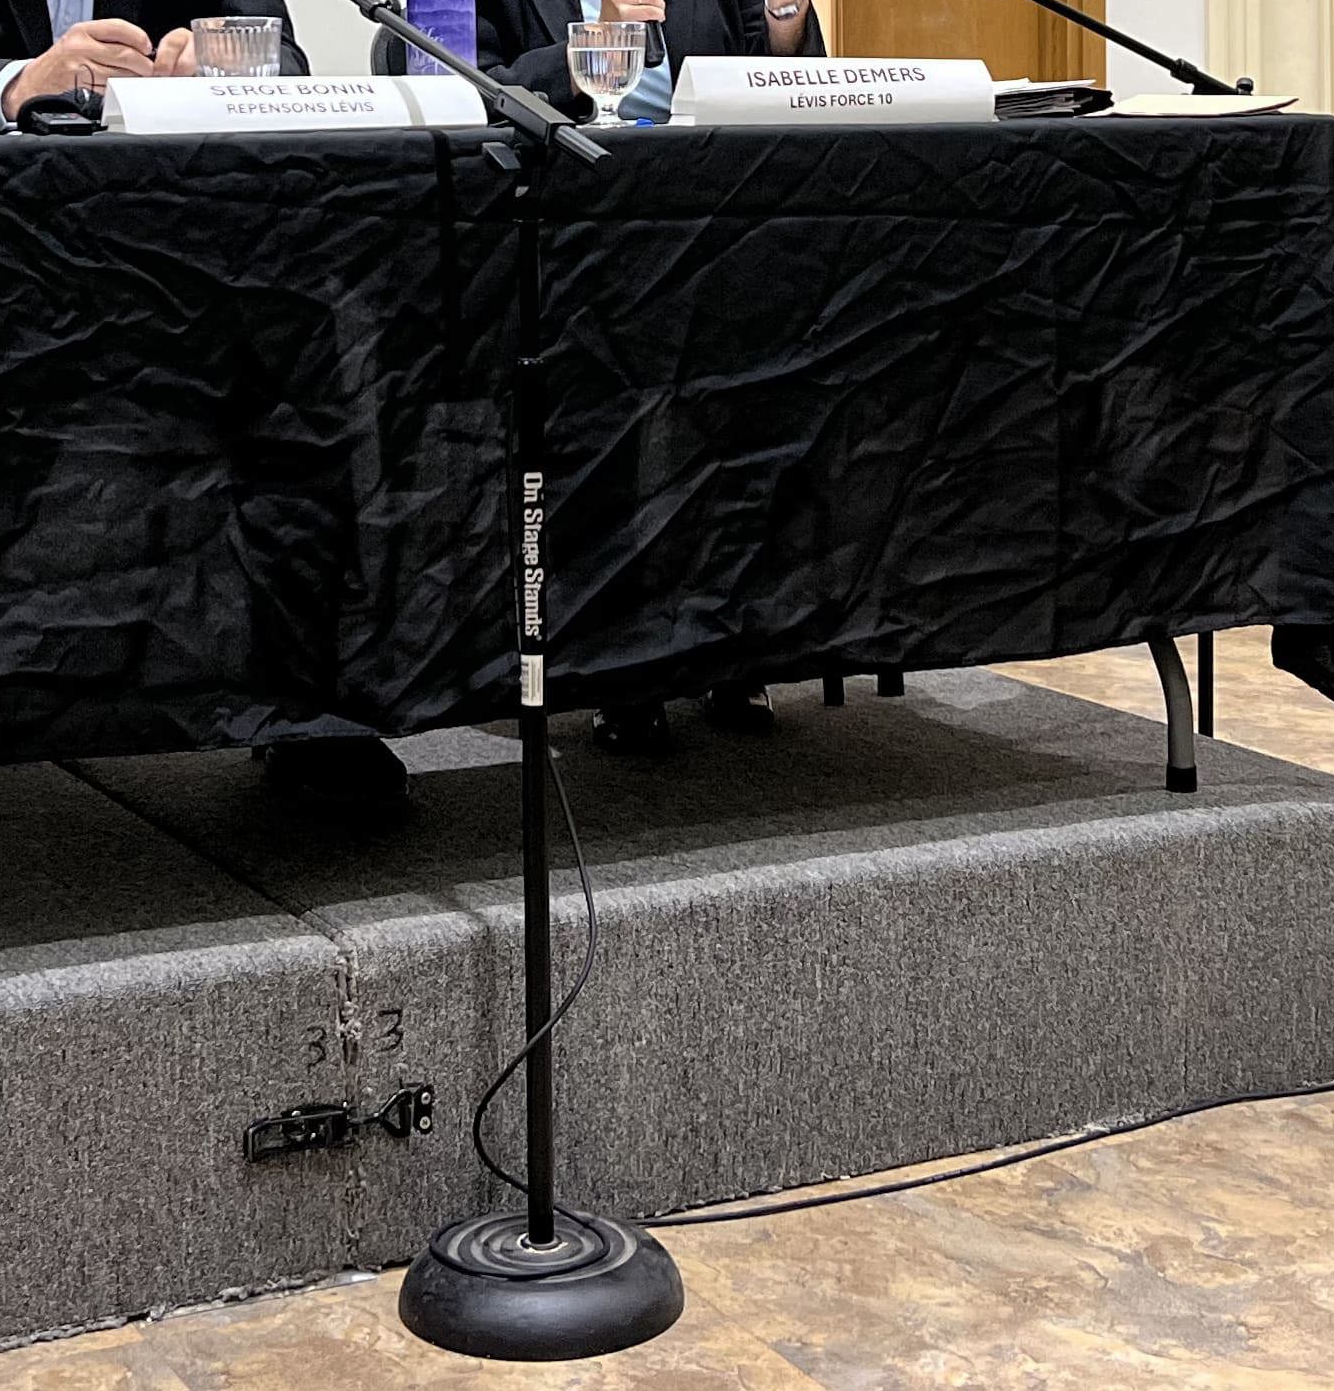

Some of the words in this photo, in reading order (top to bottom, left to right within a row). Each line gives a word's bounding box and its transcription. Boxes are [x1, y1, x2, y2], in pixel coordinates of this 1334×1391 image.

[210, 84, 288, 96] SERGE
[298, 83, 374, 95] BONIN
[746, 69, 841, 88] ISABELLE
[845, 67, 926, 84] DEMERS
[227, 102, 327, 115] REPENSONS
[331, 99, 374, 113] LÉVIS
[790, 93, 827, 109] LÉVIS
[830, 94, 875, 107] FORCE
[878, 94, 893, 106] 10
[521, 508, 544, 565] Stage
[524, 567, 544, 637] Stands
[376, 1009, 403, 1053] 3
[307, 1027, 326, 1074] 3
